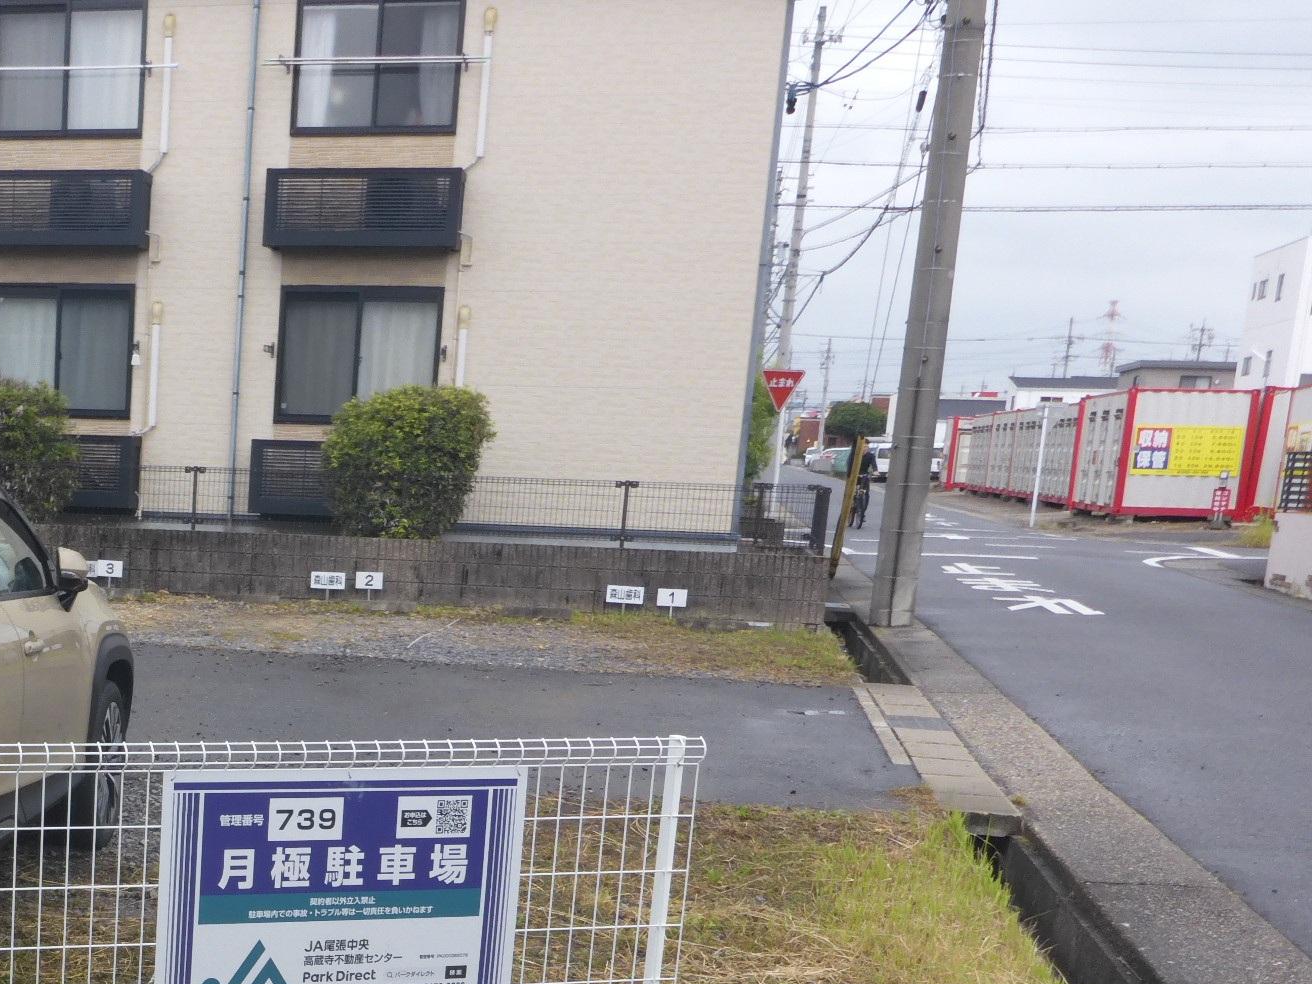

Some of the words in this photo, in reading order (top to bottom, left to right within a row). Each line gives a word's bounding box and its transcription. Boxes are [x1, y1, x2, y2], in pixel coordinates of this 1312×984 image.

[769, 377, 794, 387] 止まれ
[106, 563, 114, 574] 3
[365, 575, 374, 586] 2
[669, 592, 675, 604] 1
[219, 814, 264, 826] 管理番号
[276, 809, 336, 830] 739
[217, 844, 468, 889] 月極駐車場
[304, 939, 370, 952] JA尾張中央
[303, 953, 403, 966] 高蔵寺不動産センター
[303, 971, 333, 983] Park
[336, 969, 376, 981] Direct
